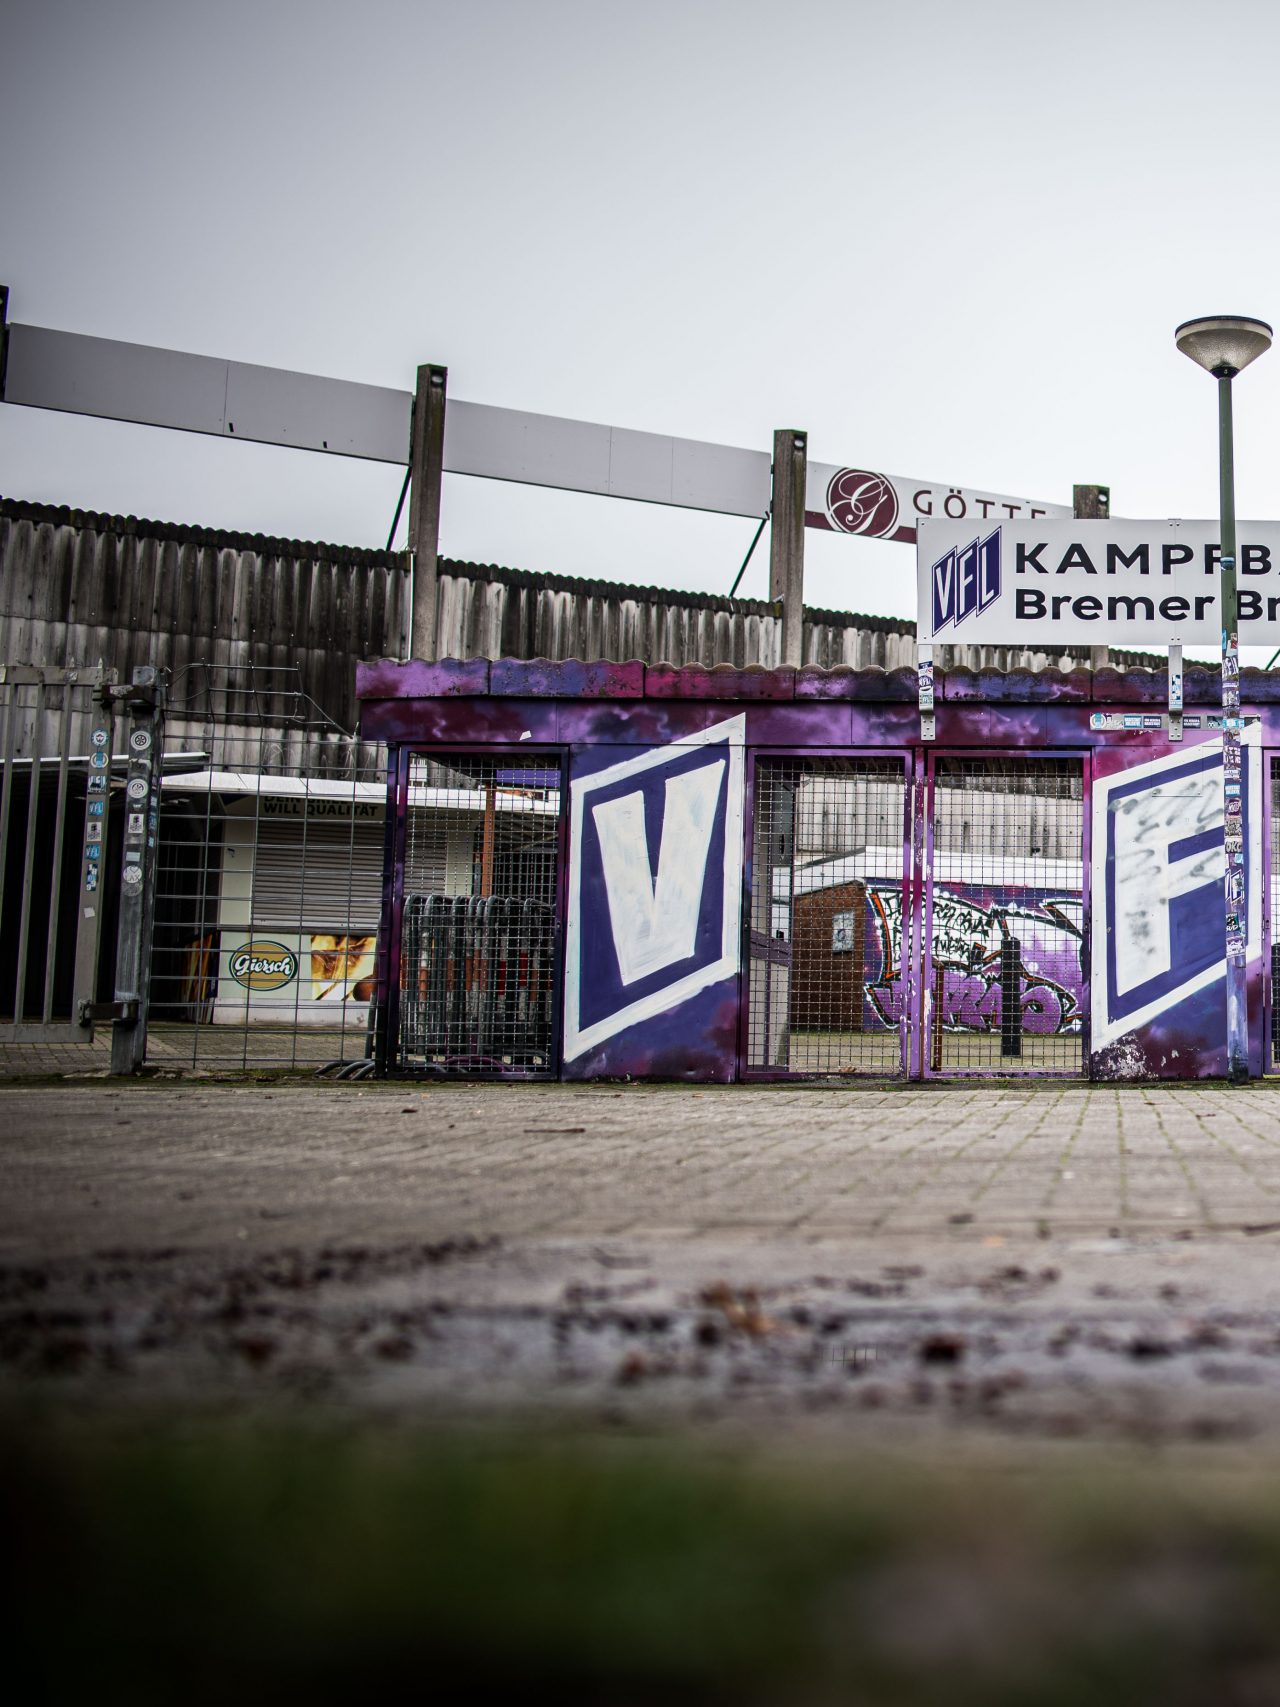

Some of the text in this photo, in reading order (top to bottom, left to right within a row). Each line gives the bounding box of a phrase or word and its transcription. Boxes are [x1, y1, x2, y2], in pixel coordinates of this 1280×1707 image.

[935, 539, 998, 624] VFL
[1016, 588, 1215, 621] Bremer
[263, 803, 378, 817] WILL QUALITÄT
[234, 955, 292, 976] Giersch
